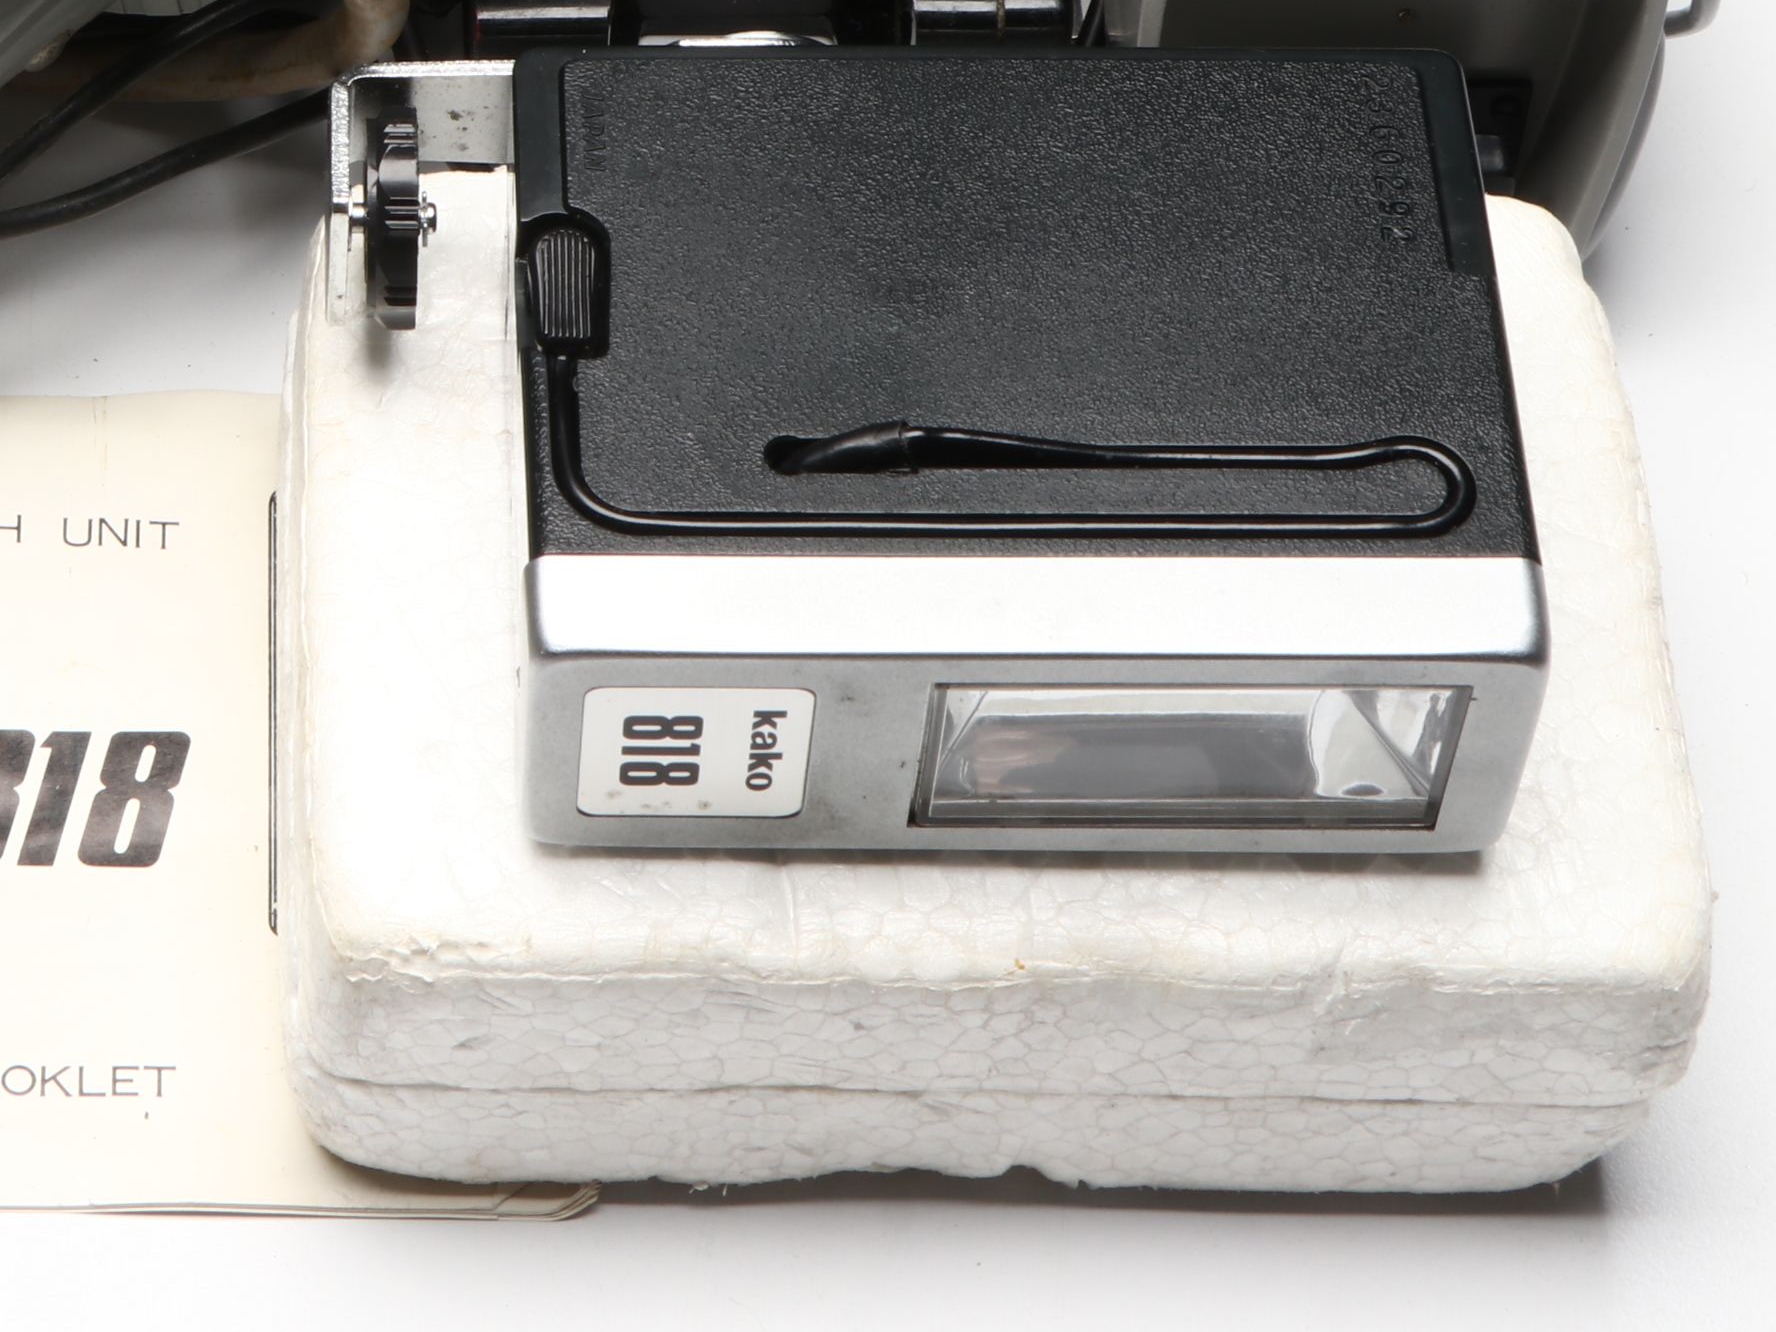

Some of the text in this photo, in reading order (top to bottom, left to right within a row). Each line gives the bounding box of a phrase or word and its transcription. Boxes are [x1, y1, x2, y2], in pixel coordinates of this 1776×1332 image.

[61, 517, 181, 551] UNIT
[618, 714, 704, 787] 818
[745, 709, 788, 792] kako
